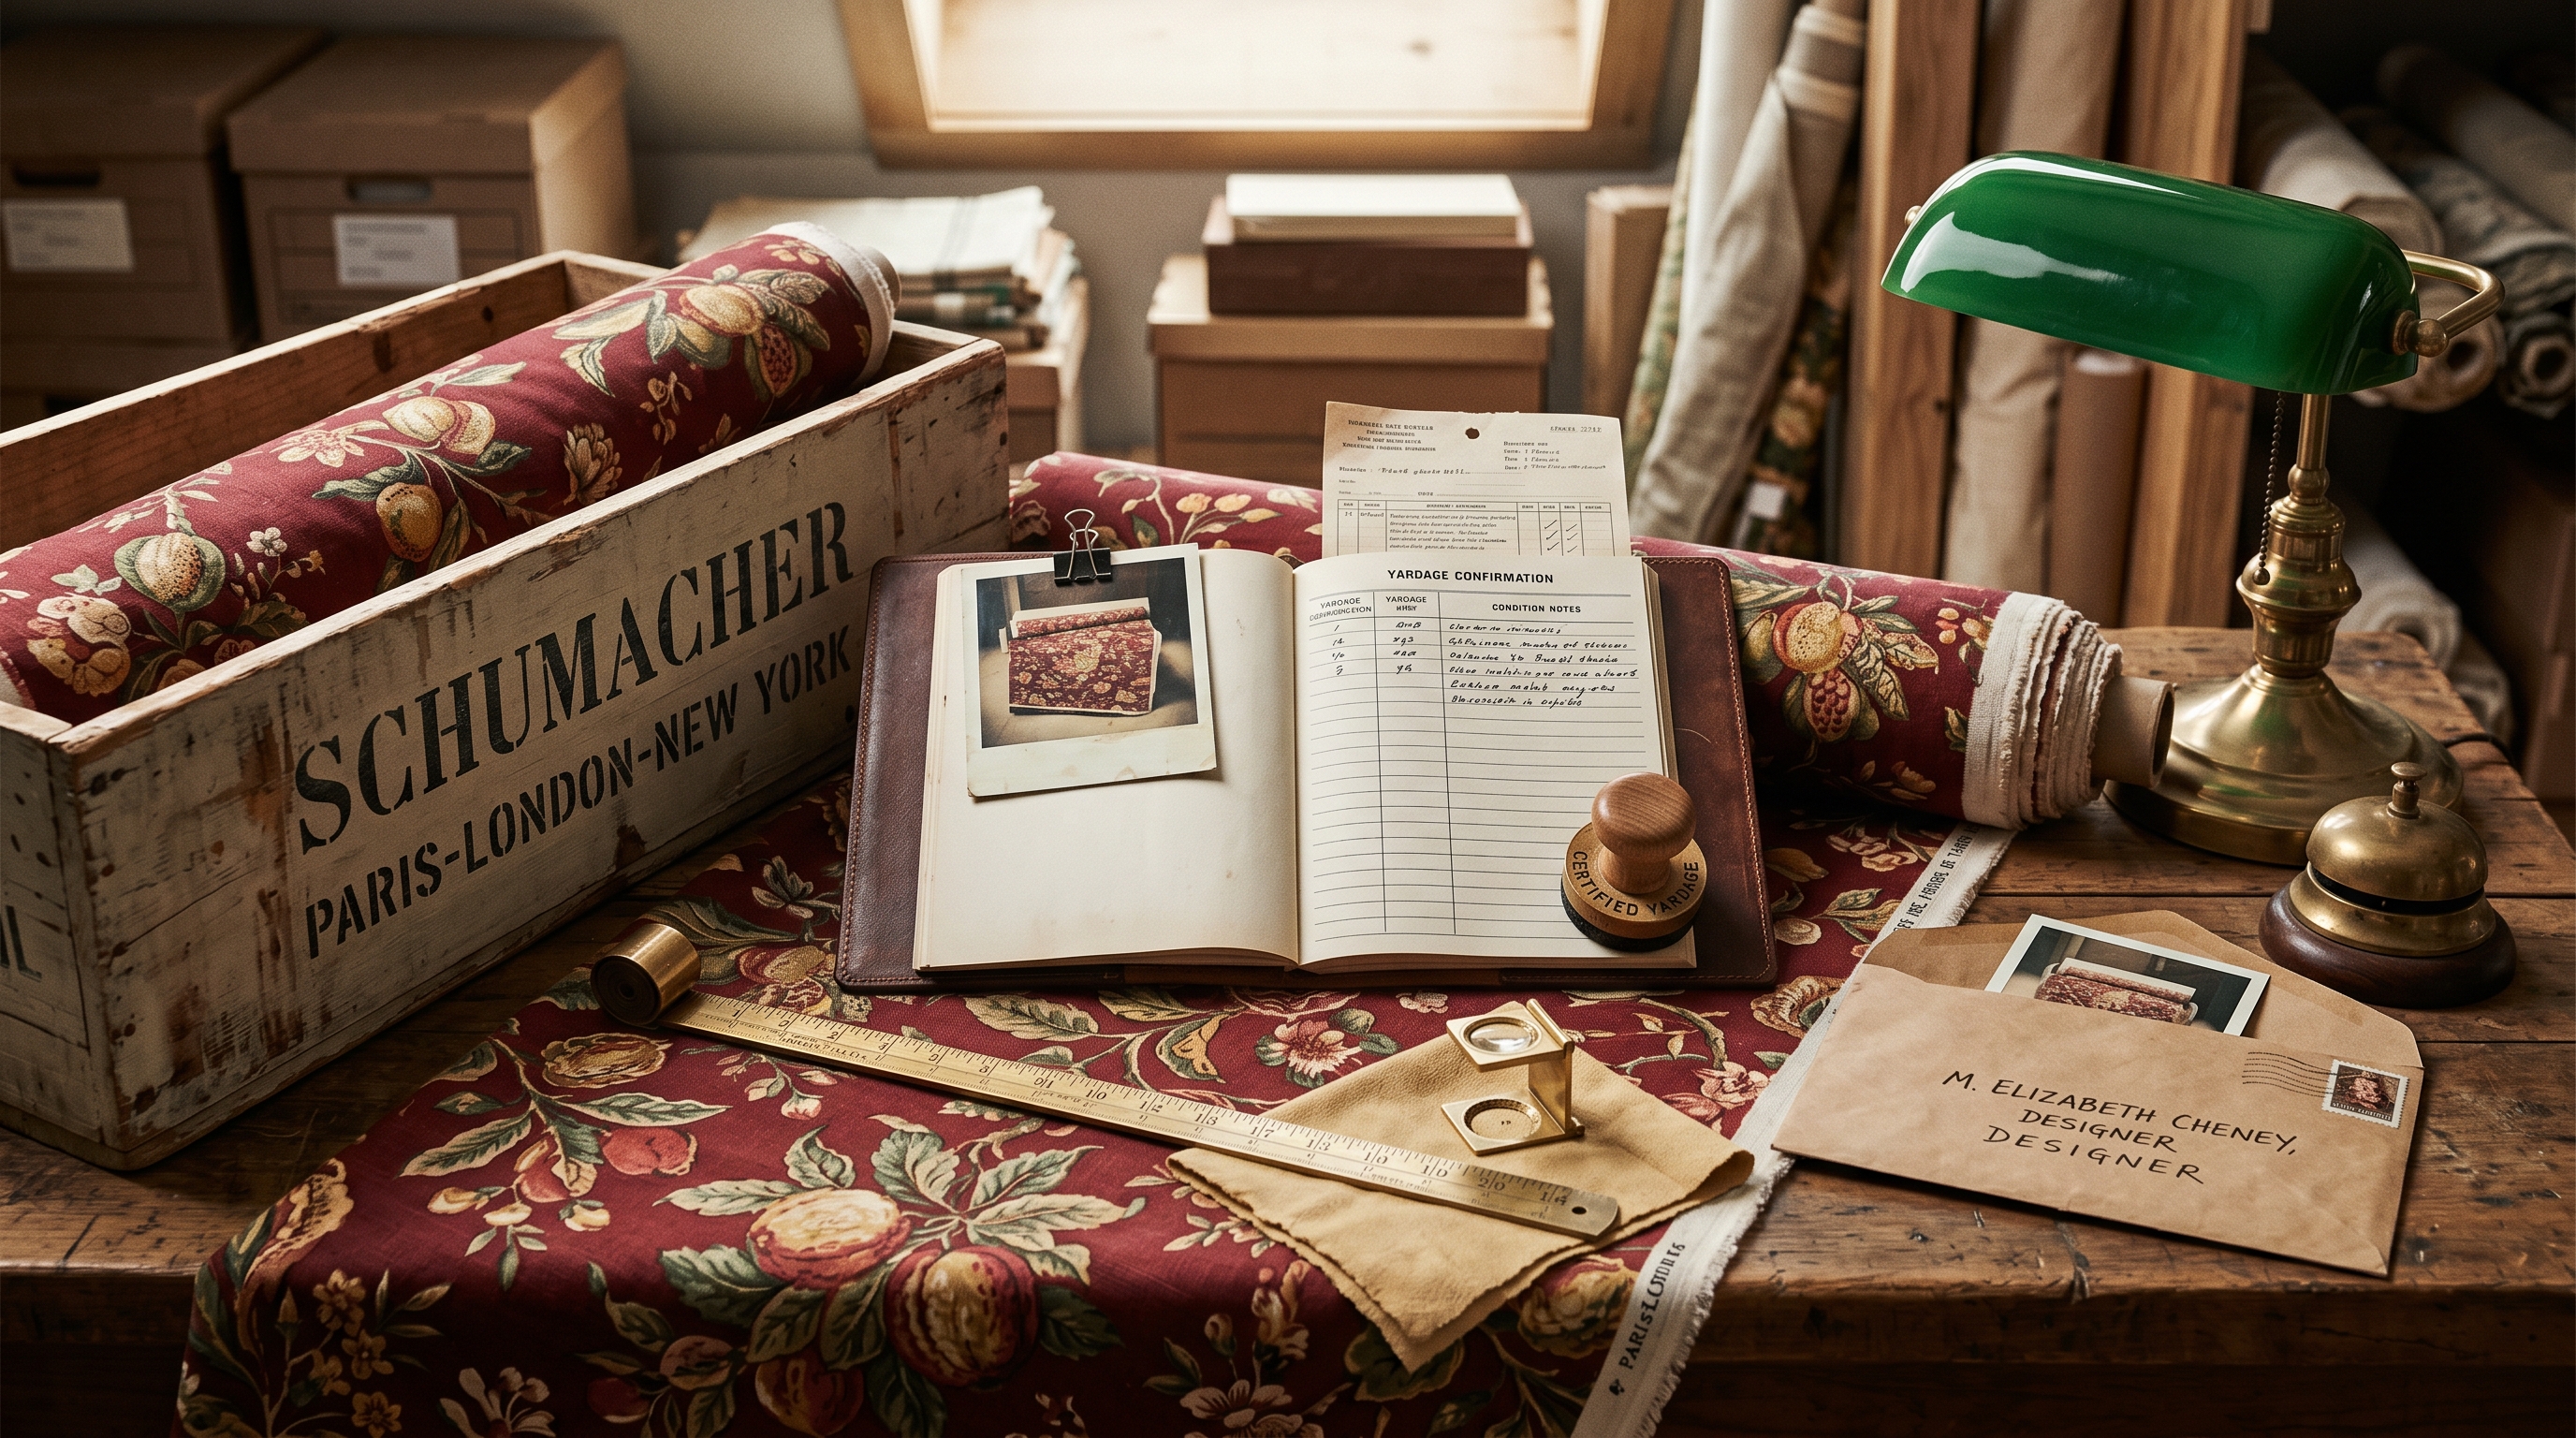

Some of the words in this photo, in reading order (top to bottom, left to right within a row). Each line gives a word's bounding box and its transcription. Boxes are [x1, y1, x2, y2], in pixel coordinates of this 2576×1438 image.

[1387, 569, 1449, 580] YARDAGE
[1455, 571, 1554, 583] CONFIRMATION
[1492, 603, 1545, 612] CONDITION
[1549, 605, 1582, 613] NOTES
[294, 501, 854, 856] SCHUMACHER
[305, 682, 739, 960] PARIS-LONDON-NEW
[754, 624, 852, 715] YORK
[1572, 850, 1639, 917] CERTIFIED
[1646, 860, 1699, 917] YARDAGE
[1942, 1070, 1977, 1092] M.
[1991, 1078, 2157, 1123] ELIZABETH
[2172, 1114, 2297, 1156] CHENEY,
[2018, 1108, 2178, 1153] DESIGNER
[1983, 1124, 2204, 1185] DESIGNER
